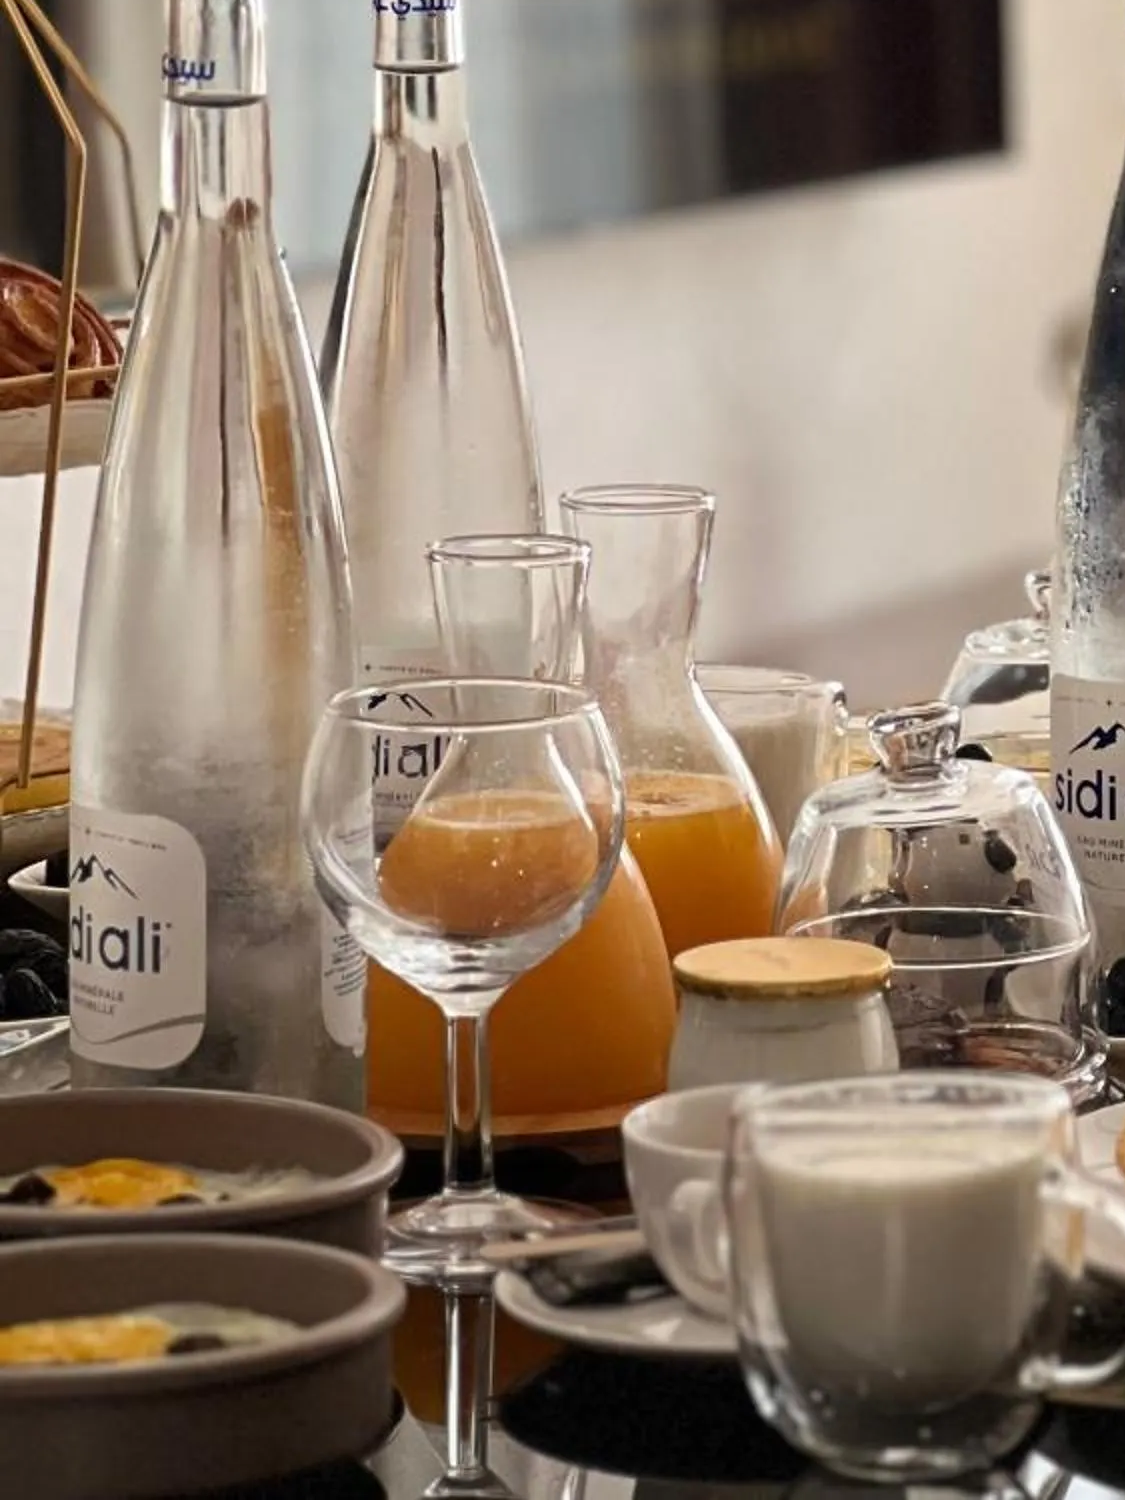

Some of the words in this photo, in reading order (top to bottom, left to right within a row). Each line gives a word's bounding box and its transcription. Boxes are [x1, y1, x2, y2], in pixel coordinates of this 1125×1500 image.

[398, 734, 452, 778] al
[1055, 768, 1117, 821] sidi
[99, 916, 162, 974] ali
